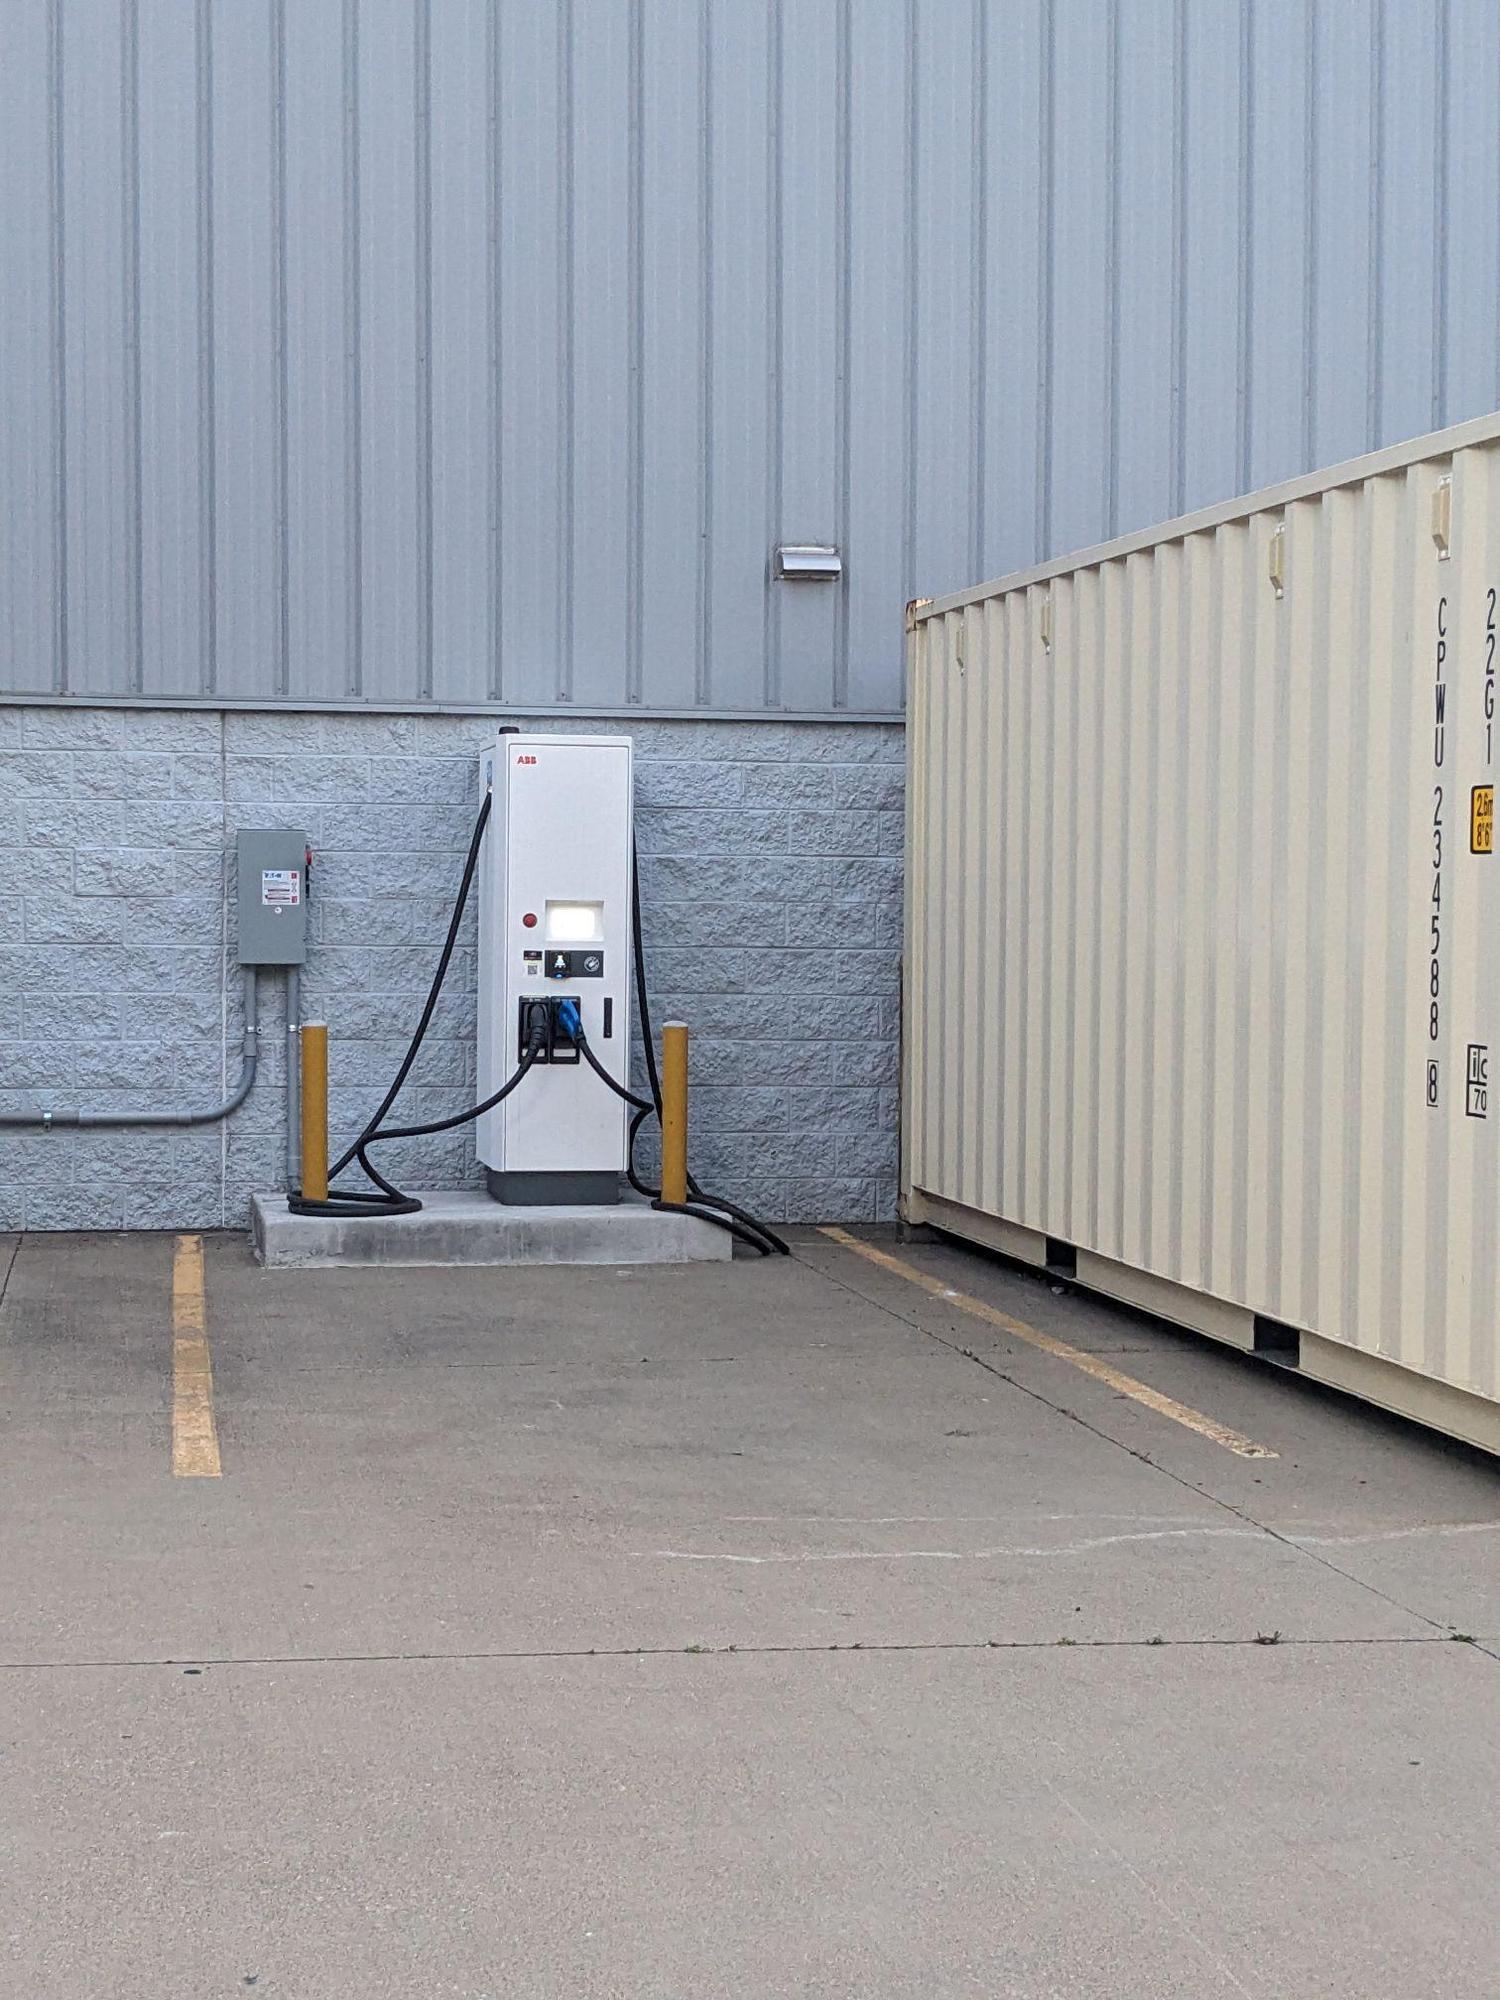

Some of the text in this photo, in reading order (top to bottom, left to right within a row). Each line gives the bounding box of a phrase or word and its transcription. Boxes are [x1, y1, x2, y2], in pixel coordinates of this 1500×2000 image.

[517, 755, 537, 765] ABB
[1435, 597, 1447, 767] CPWU
[1485, 588, 1496, 764] 22G1
[1430, 786, 1443, 1041] 234588
[1474, 1088, 1487, 1111] 70
